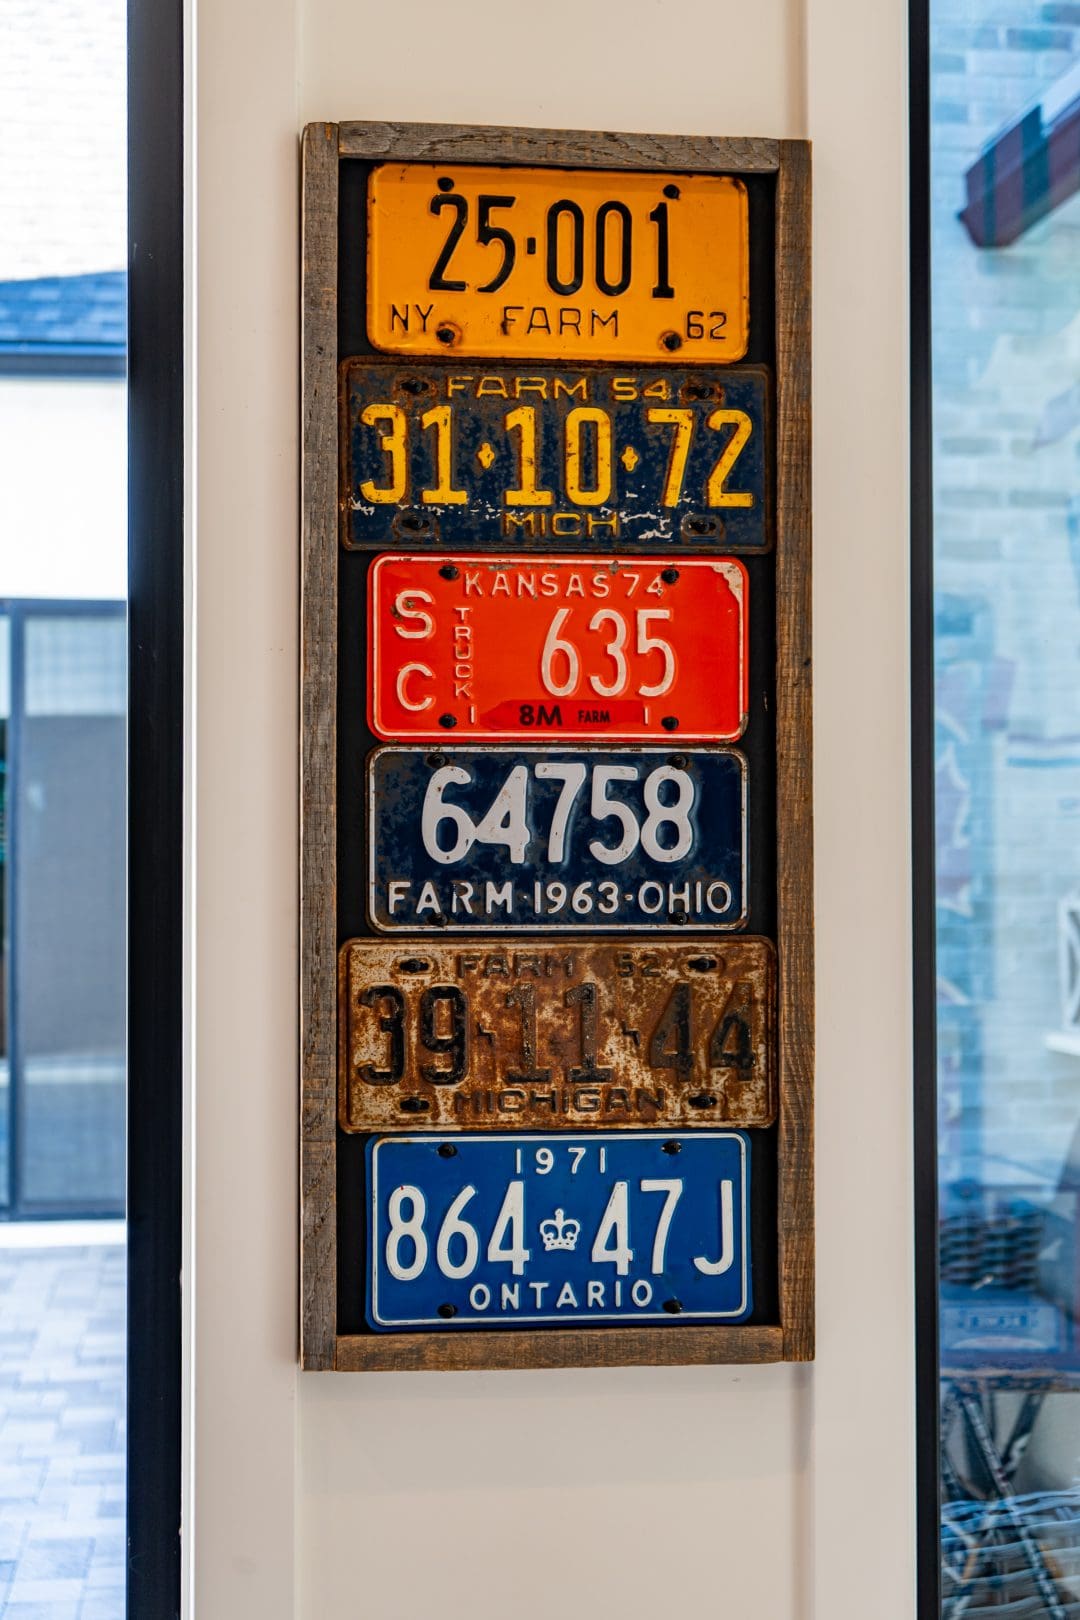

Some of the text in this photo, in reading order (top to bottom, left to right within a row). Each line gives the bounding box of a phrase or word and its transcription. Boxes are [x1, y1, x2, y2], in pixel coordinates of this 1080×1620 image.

[391, 303, 728, 341] NY FARM 62
[447, 375, 670, 401] FARM 54
[505, 512, 618, 537] MICH
[465, 572, 664, 598] KANSAS 74
[454, 607, 473, 697] TRUCK
[541, 608, 675, 698] 635
[518, 704, 611, 727] 8M FARM
[421, 762, 695, 865] 64758
[457, 953, 662, 979] FARM 52
[455, 1088, 665, 1114] MICHIGAN
[516, 1147, 607, 1175] 1971
[385, 1181, 531, 1281] 864
[469, 1280, 653, 1311] ONTARIO
